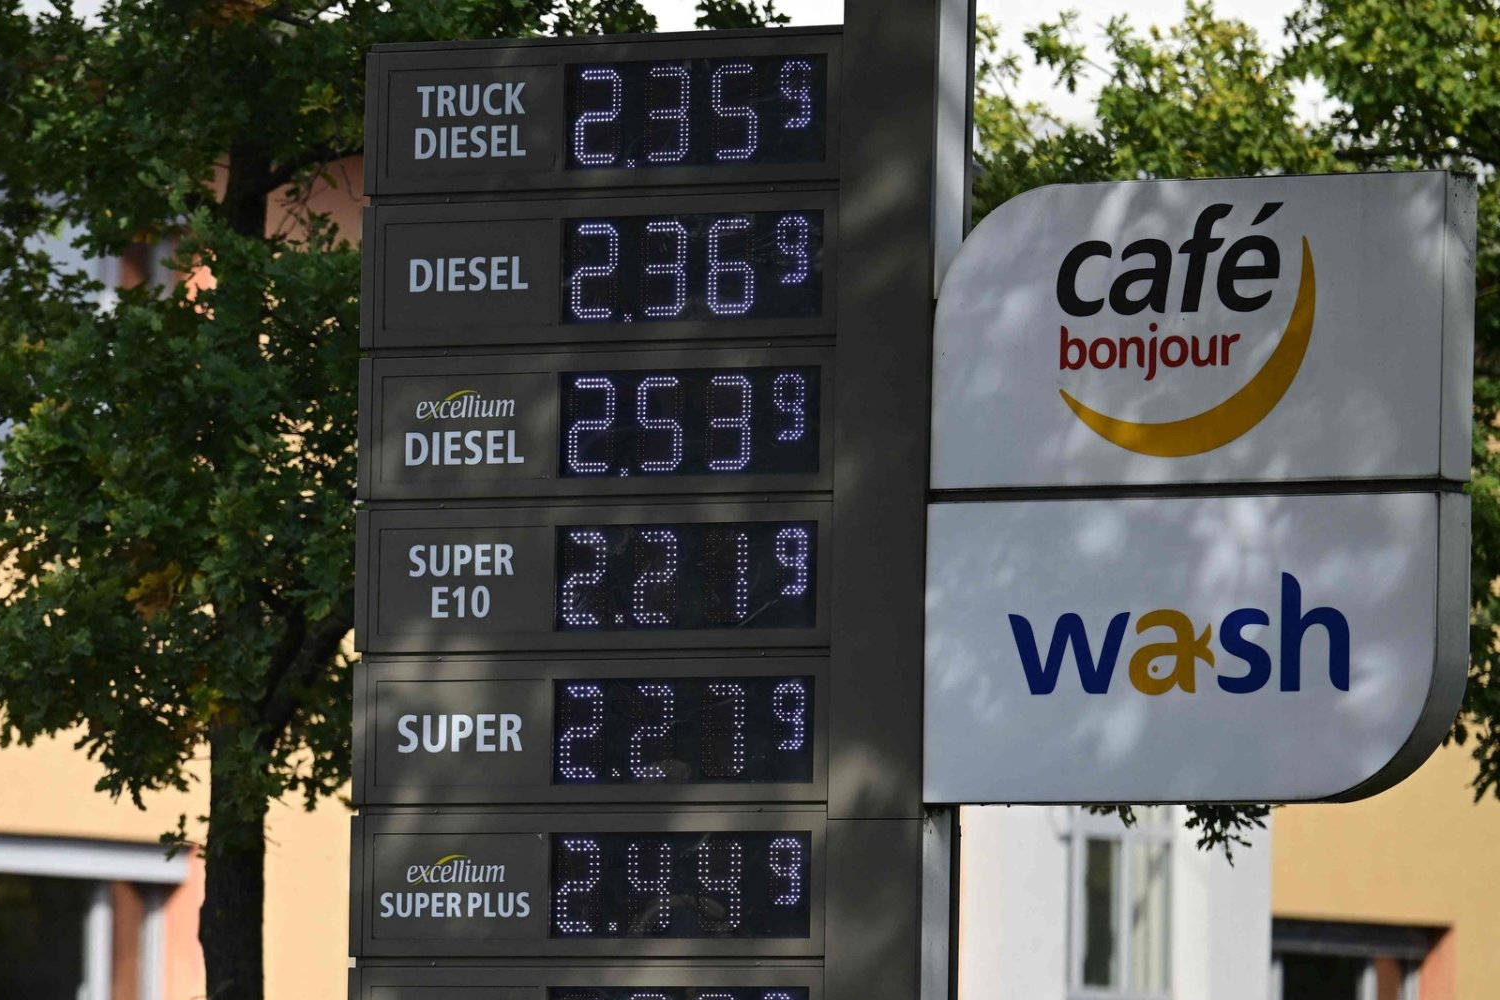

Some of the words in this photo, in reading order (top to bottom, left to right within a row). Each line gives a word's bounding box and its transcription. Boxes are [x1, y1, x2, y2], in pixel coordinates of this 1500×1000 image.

[417, 82, 526, 118] TRUCK
[414, 125, 526, 160] DIESEL
[409, 256, 529, 293] DIESEL
[1056, 201, 1285, 318] café
[1059, 323, 1241, 381] bonjour
[415, 394, 516, 422] excellium
[405, 429, 525, 466] DIESEL
[408, 543, 514, 578] SUPER
[431, 585, 491, 619] E10
[1008, 572, 1351, 696] wash
[397, 713, 523, 754] SUPER
[406, 858, 506, 885] excellium
[380, 892, 462, 918] SUPER
[467, 891, 531, 919] PLUS
